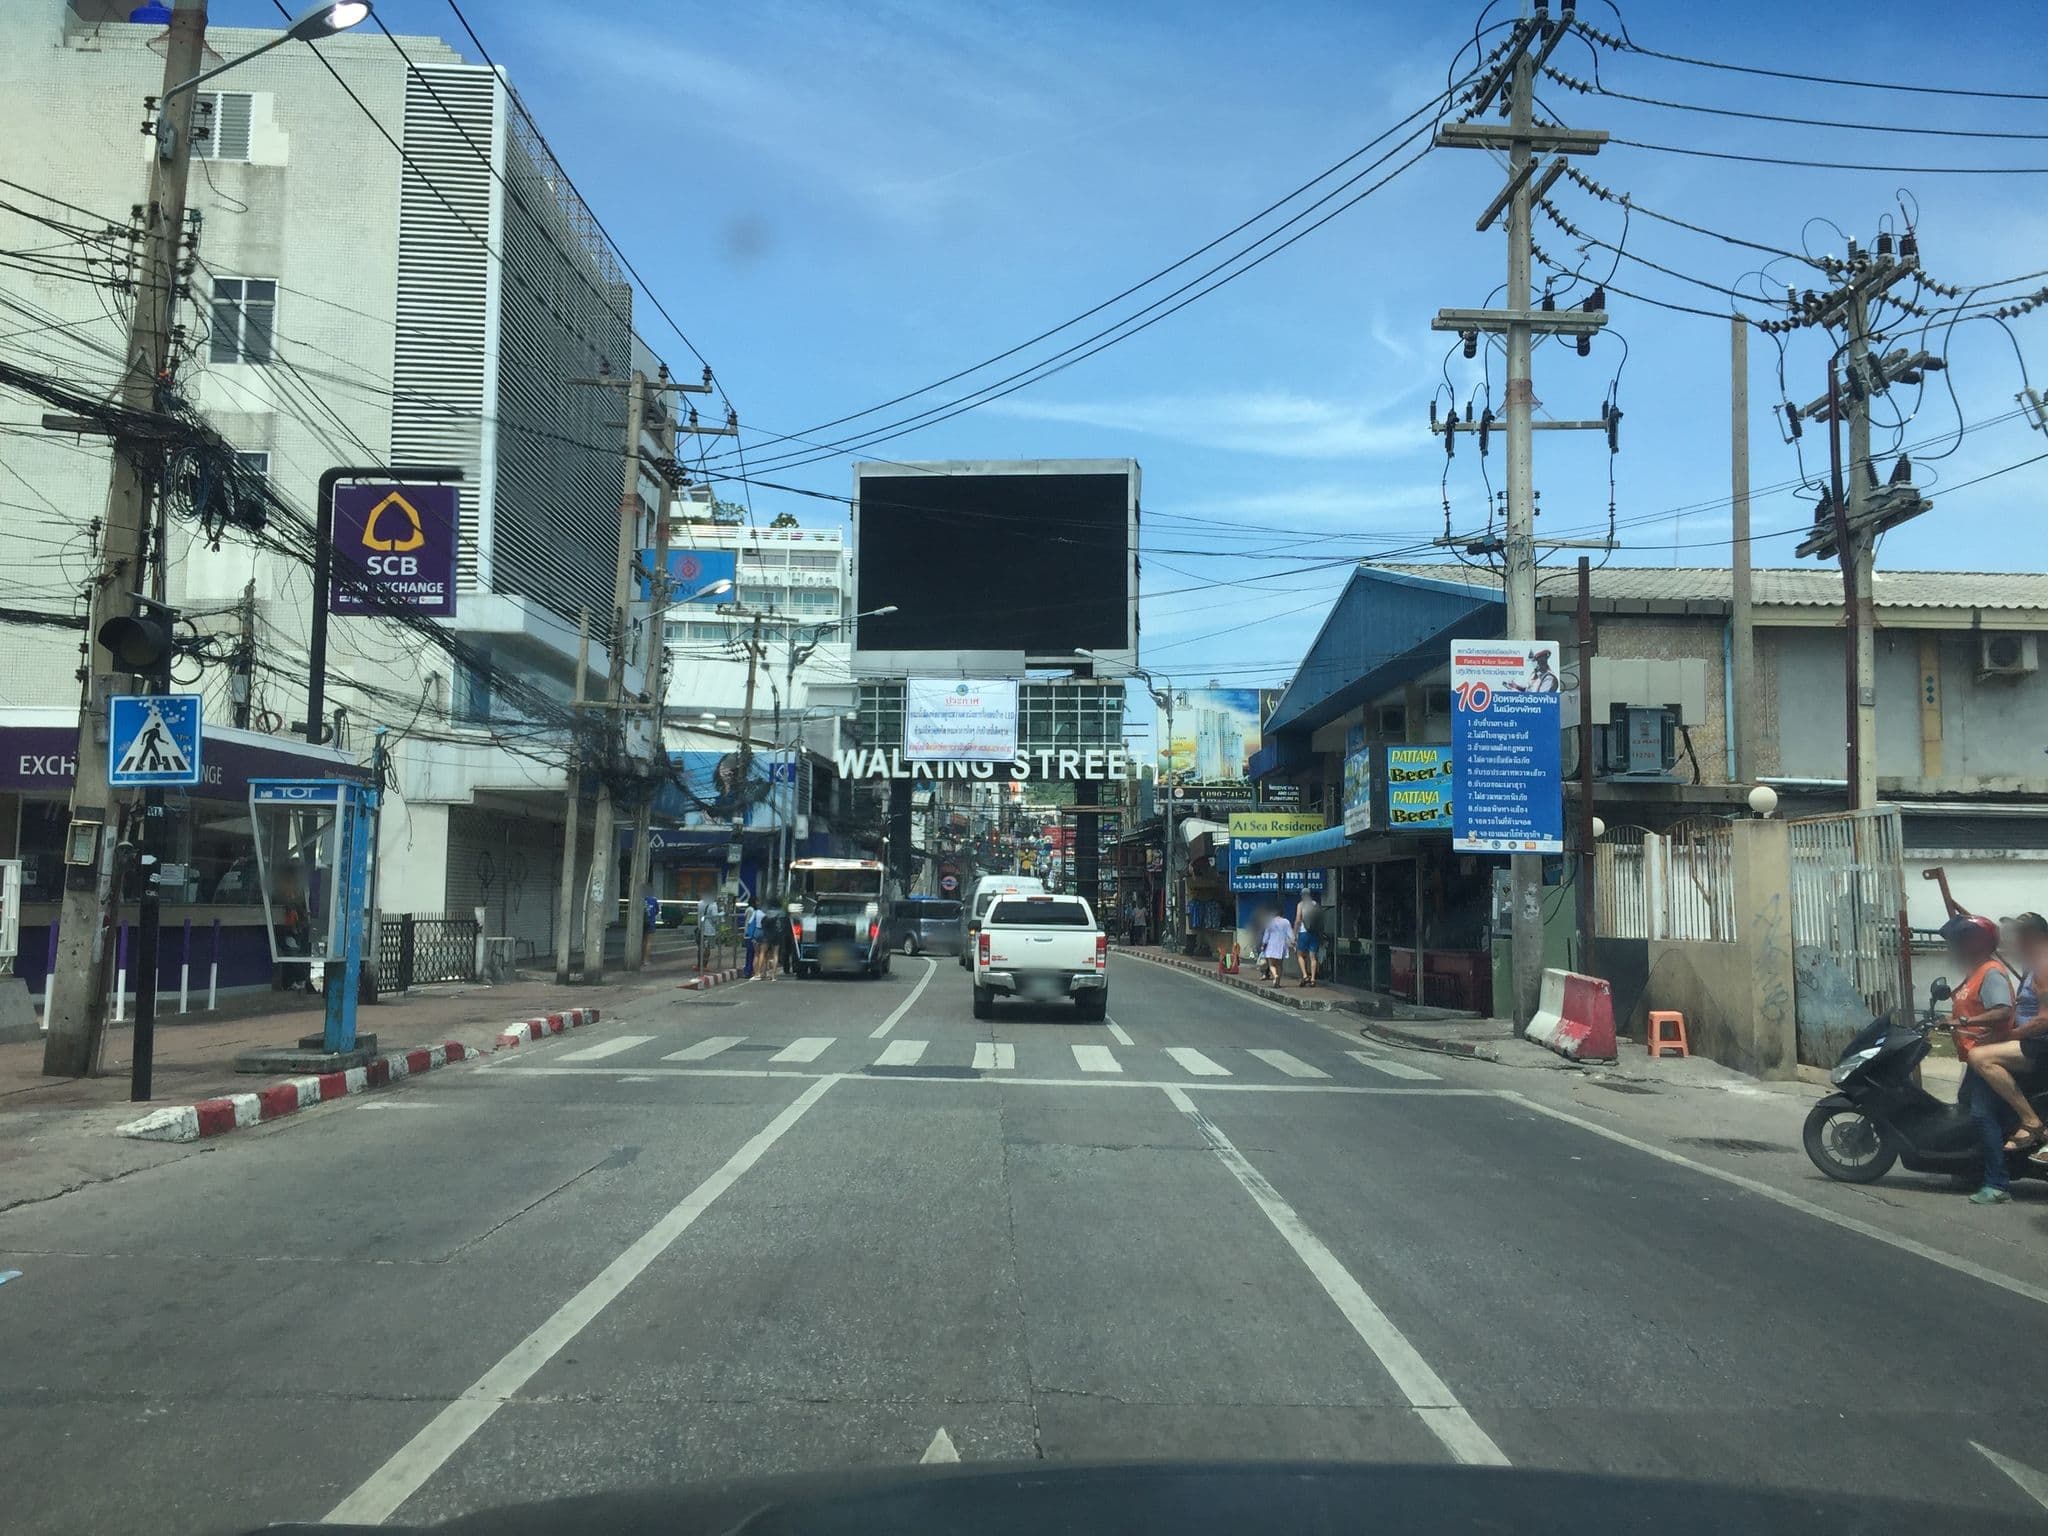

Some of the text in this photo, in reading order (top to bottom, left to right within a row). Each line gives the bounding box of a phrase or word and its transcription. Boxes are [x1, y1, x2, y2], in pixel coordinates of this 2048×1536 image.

[367, 556, 418, 576] SCB
[1456, 681, 1492, 713] 10
[1391, 750, 1437, 764] PATTAYA
[834, 749, 1147, 780] WALKING STREET
[1390, 767, 1437, 782] Beer
[274, 787, 321, 798] TOT
[1393, 791, 1439, 805] PATTAYA
[1391, 808, 1438, 822] Beer
[1233, 820, 1323, 832] At Sea Residence
